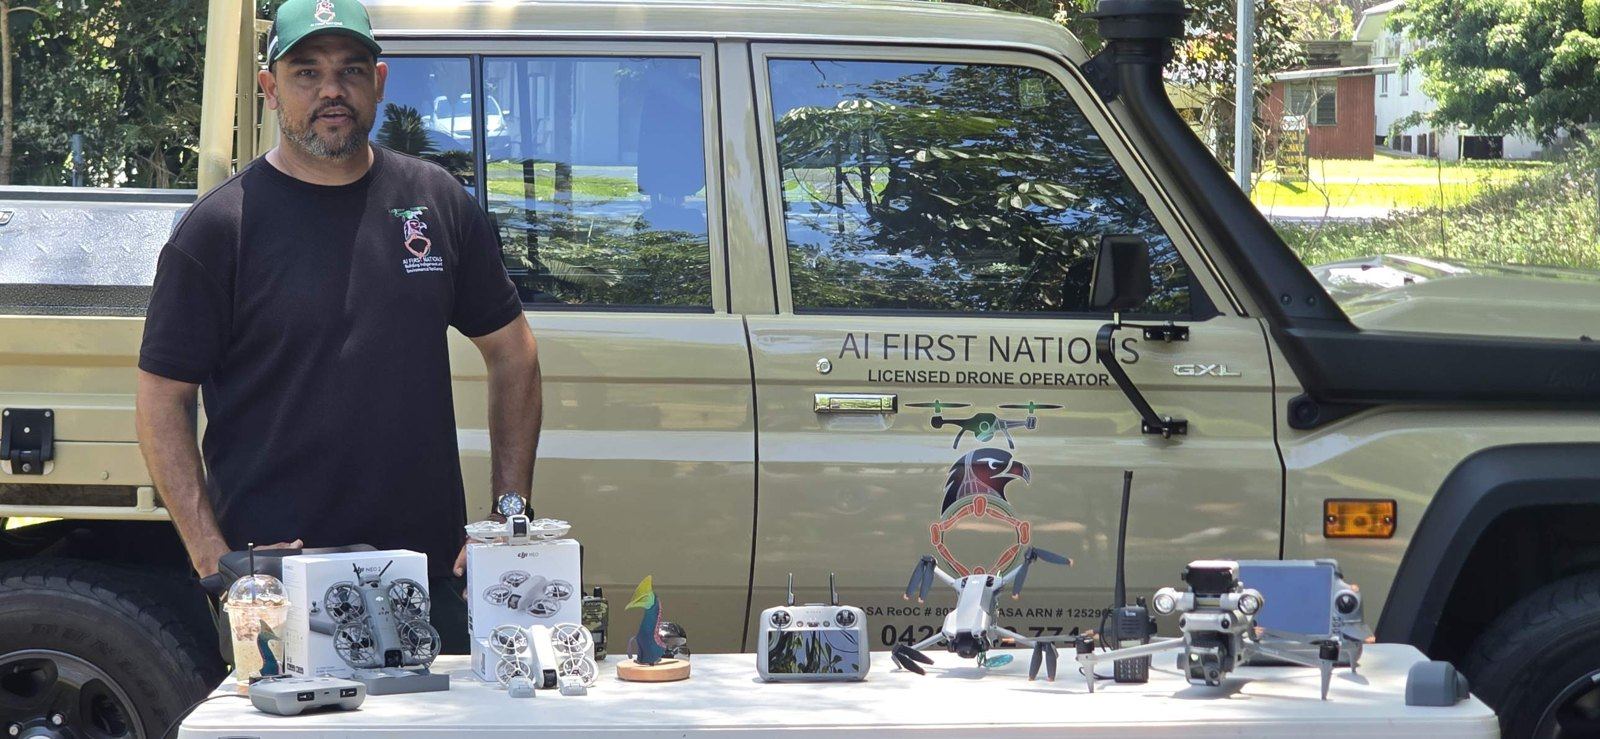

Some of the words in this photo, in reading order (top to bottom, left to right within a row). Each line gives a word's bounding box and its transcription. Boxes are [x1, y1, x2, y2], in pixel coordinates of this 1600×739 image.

[838, 332, 869, 359] AI
[883, 333, 978, 362] FIRST
[868, 369, 950, 384] LICENSED
[956, 371, 1014, 385] DRONE
[1019, 372, 1109, 387] OPERATOR
[1173, 364, 1242, 377] GXL
[860, 606, 883, 616] SA
[887, 606, 921, 617] ReOC
[924, 607, 932, 617] #
[998, 607, 1023, 618] ASA
[1026, 608, 1053, 618] ARN
[1055, 608, 1063, 618] #
